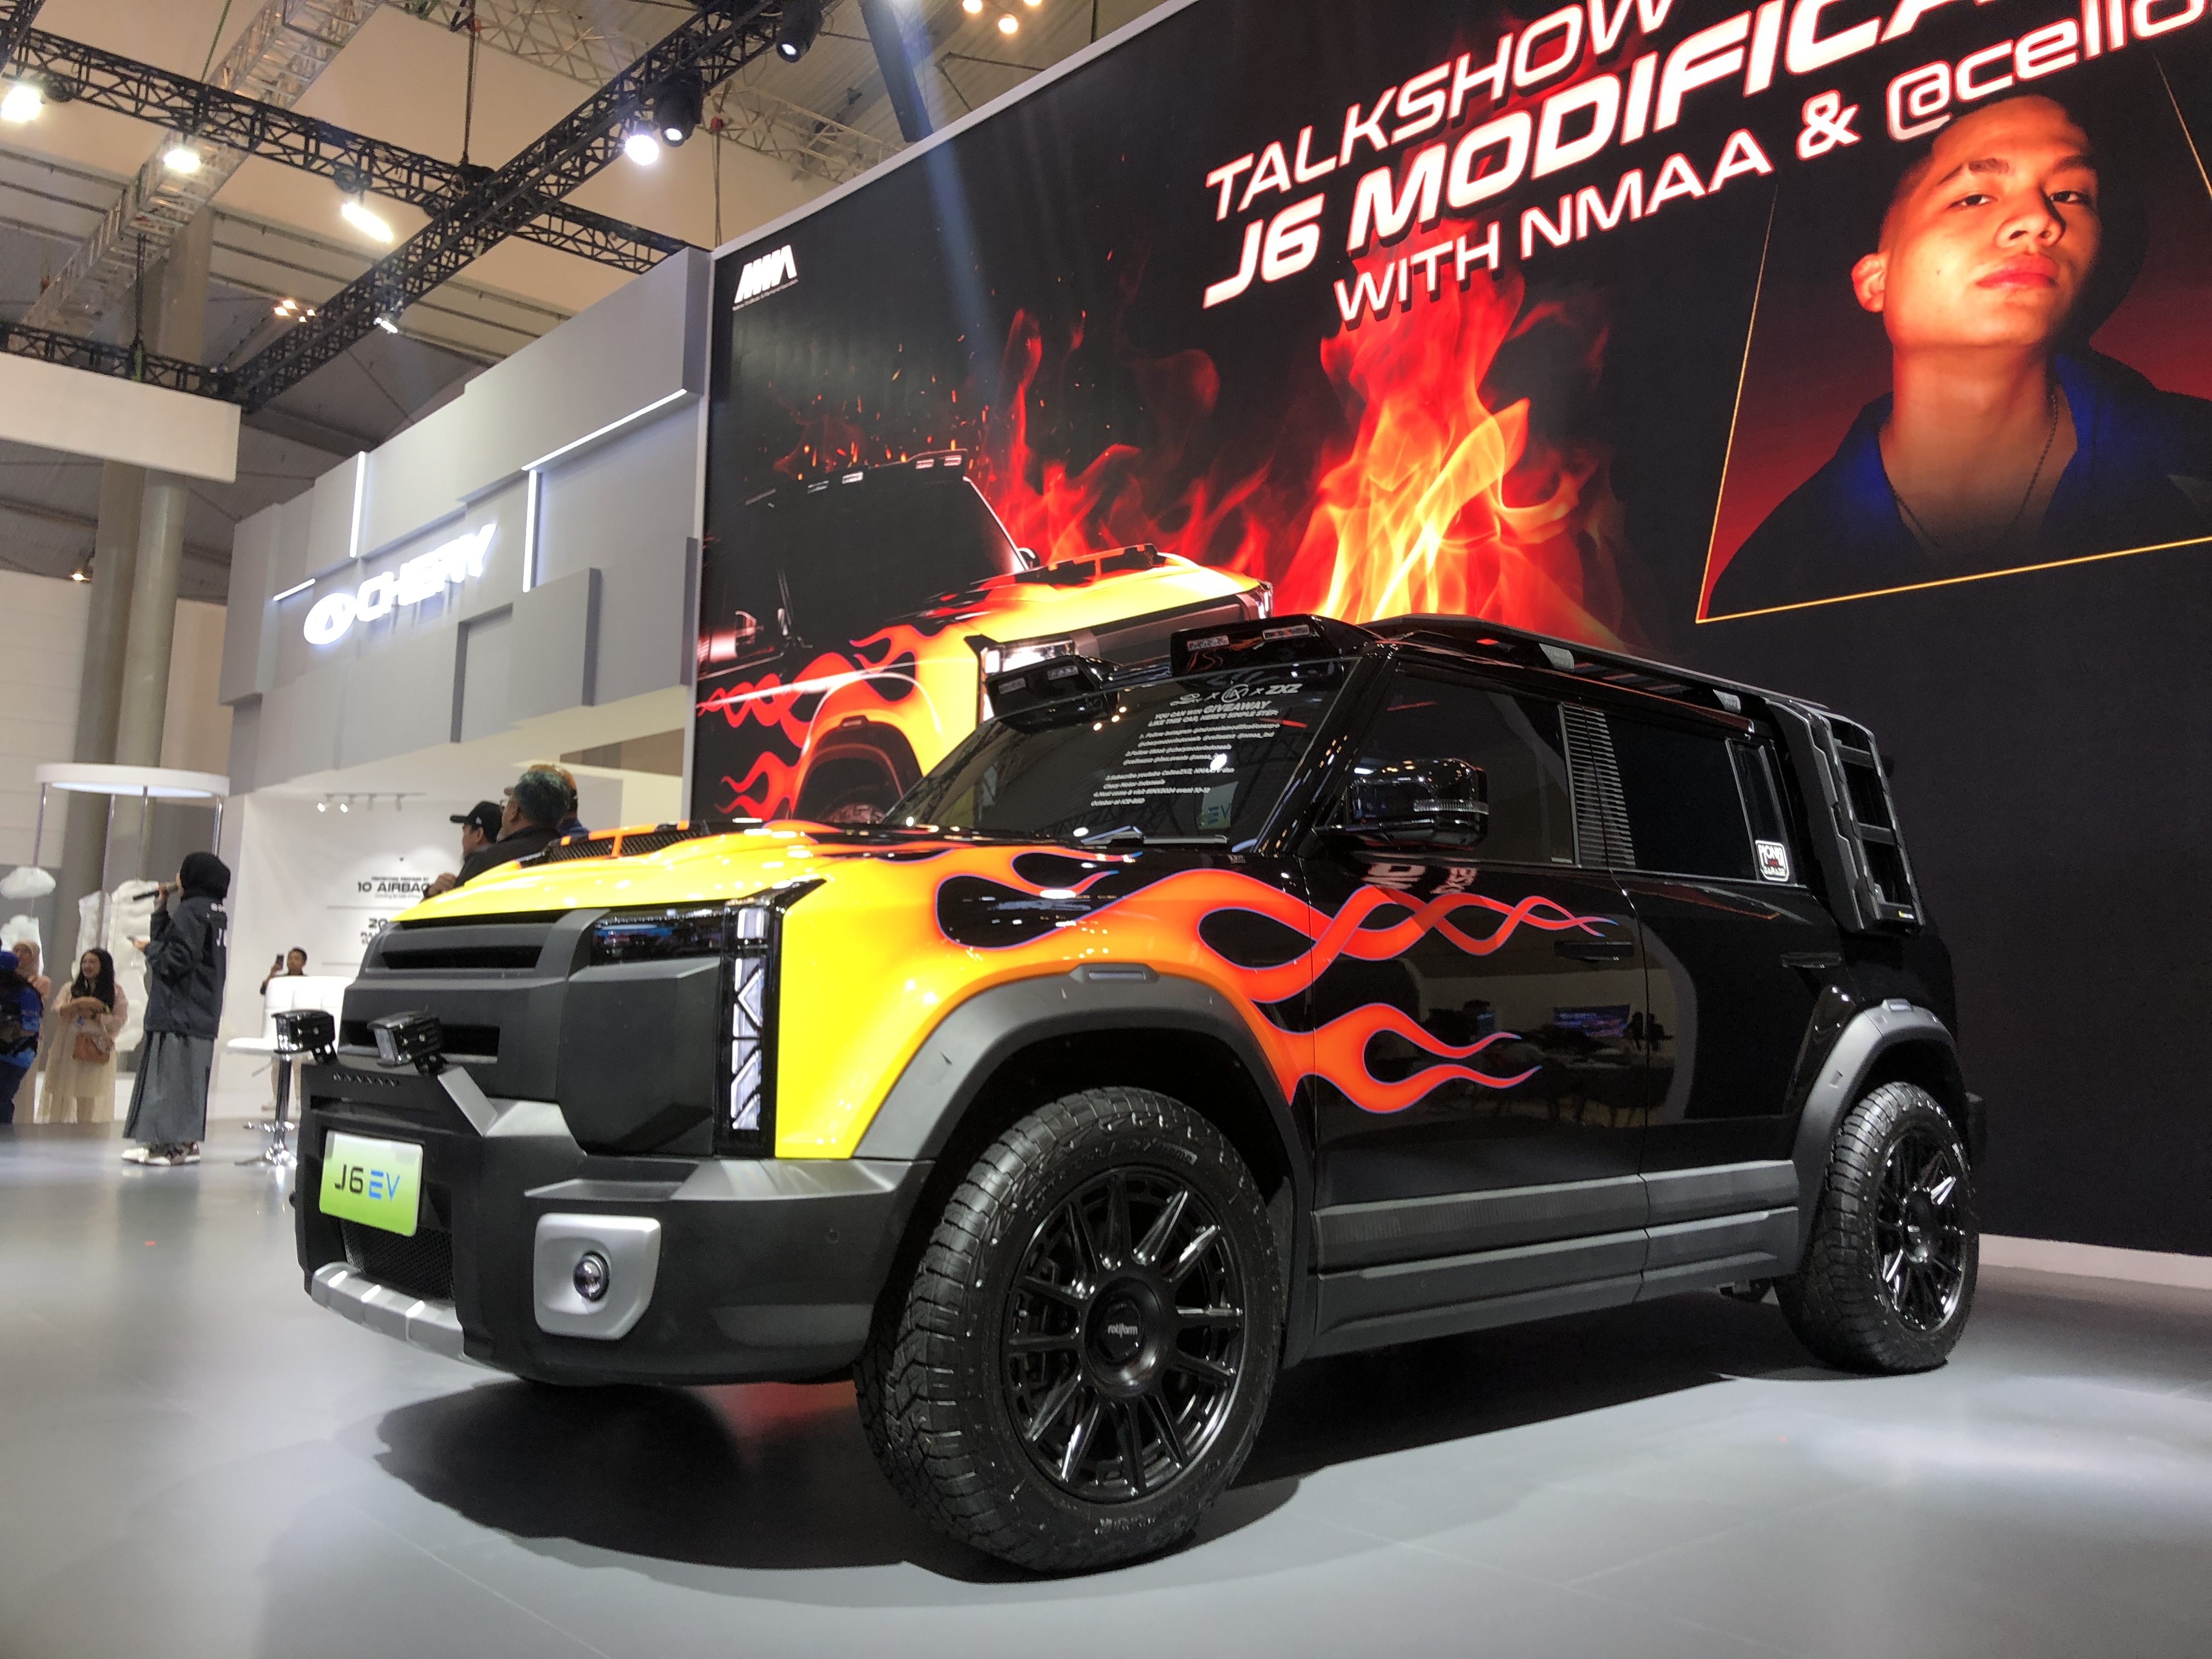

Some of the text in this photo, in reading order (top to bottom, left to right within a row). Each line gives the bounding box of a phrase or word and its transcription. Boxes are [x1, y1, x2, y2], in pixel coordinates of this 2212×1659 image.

[1206, 0, 1672, 221] TALKSHOW
[1334, 221, 1500, 323] WITH
[1520, 128, 1774, 260] NMAA
[1796, 89, 1862, 161] &
[1203, 193, 1325, 309] J6
[1203, 700, 1272, 714] GIVEAWAY
[1265, 684, 1303, 695] ZXZ
[357, 881, 373, 893] 10
[334, 1163, 400, 1203] J6EV
